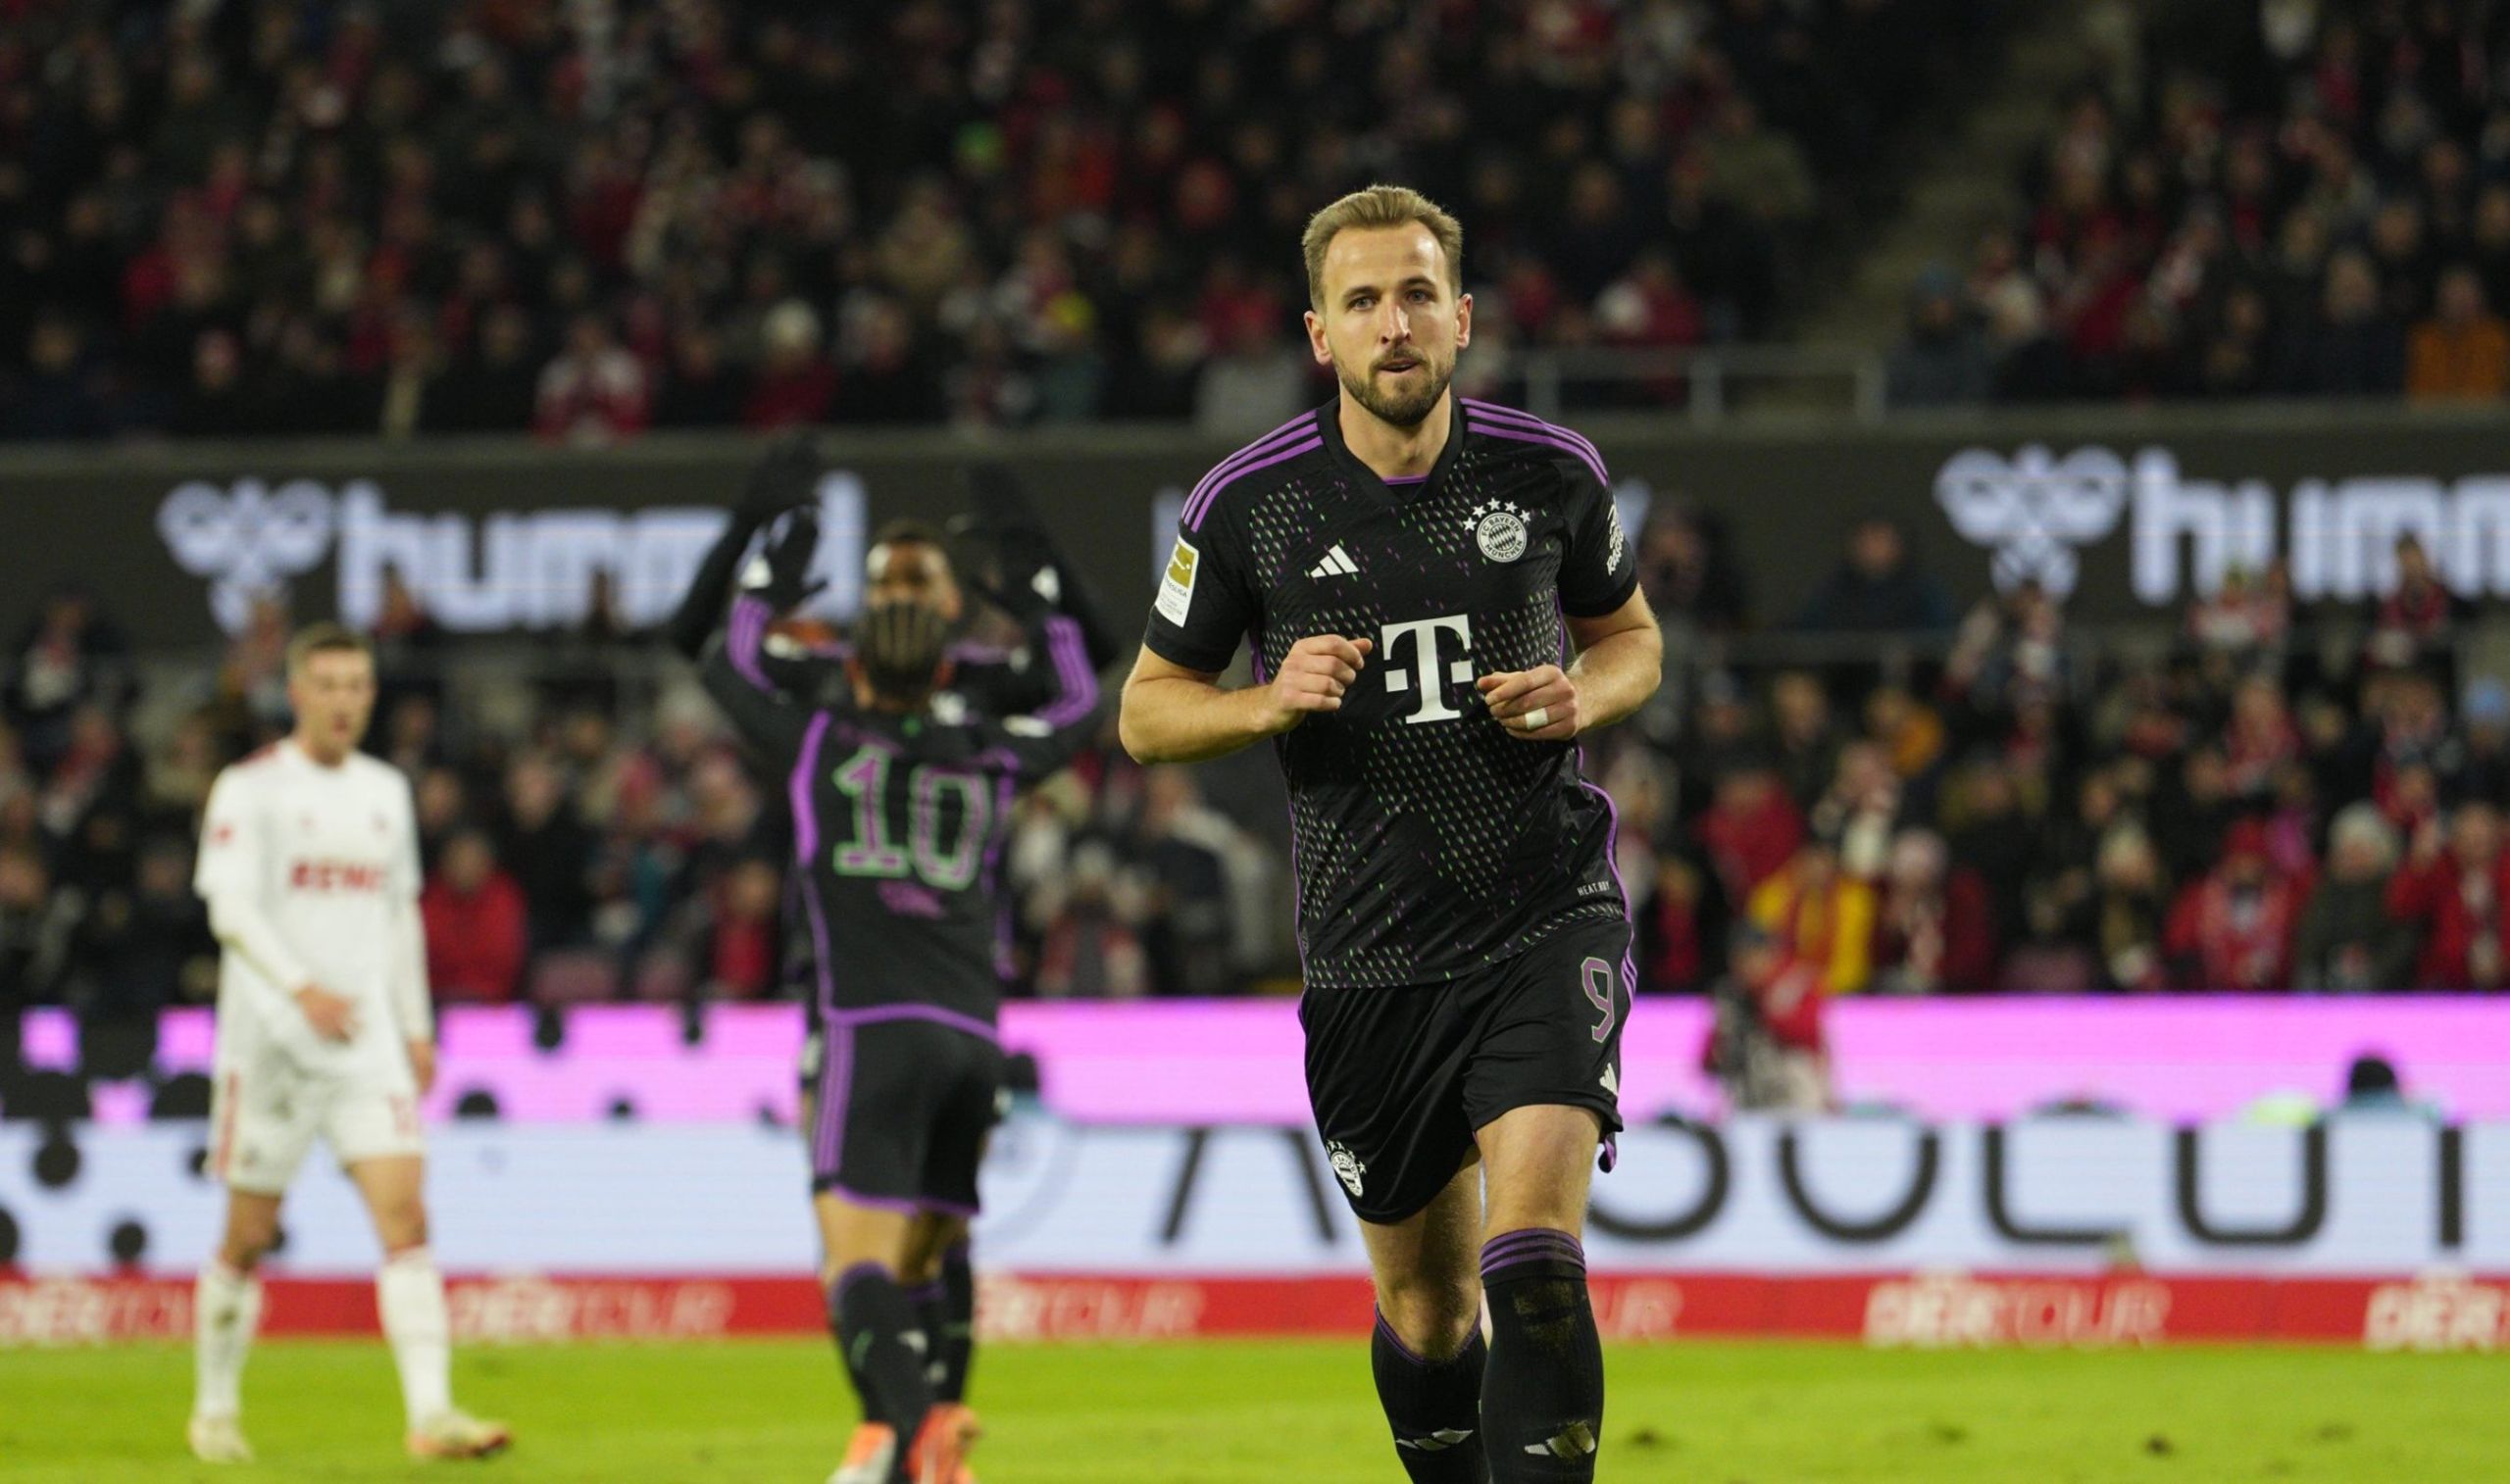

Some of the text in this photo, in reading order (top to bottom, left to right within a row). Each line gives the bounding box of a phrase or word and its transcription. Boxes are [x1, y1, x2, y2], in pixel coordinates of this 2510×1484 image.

[339, 473, 869, 629] humml
[1488, 517, 1521, 532] BAYERN
[832, 743, 990, 891] 10
[1581, 957, 1615, 1043] 9
